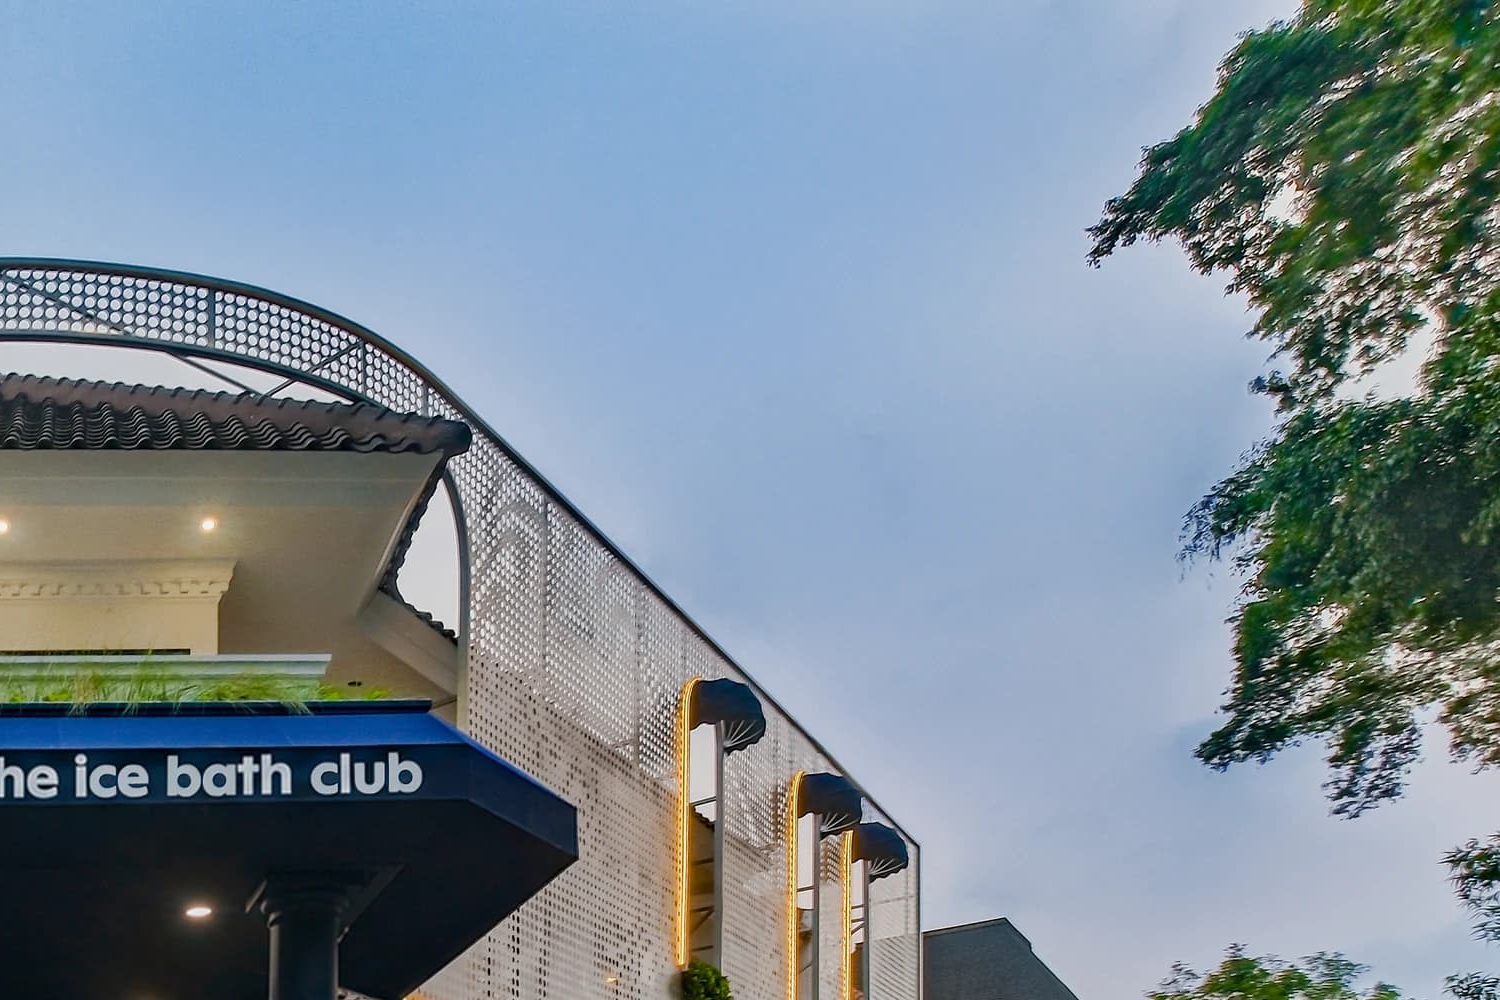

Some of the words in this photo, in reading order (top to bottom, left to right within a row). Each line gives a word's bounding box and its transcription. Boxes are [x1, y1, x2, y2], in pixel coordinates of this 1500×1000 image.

[74, 754, 149, 799] ice
[166, 754, 292, 797] bath
[310, 752, 423, 795] club
